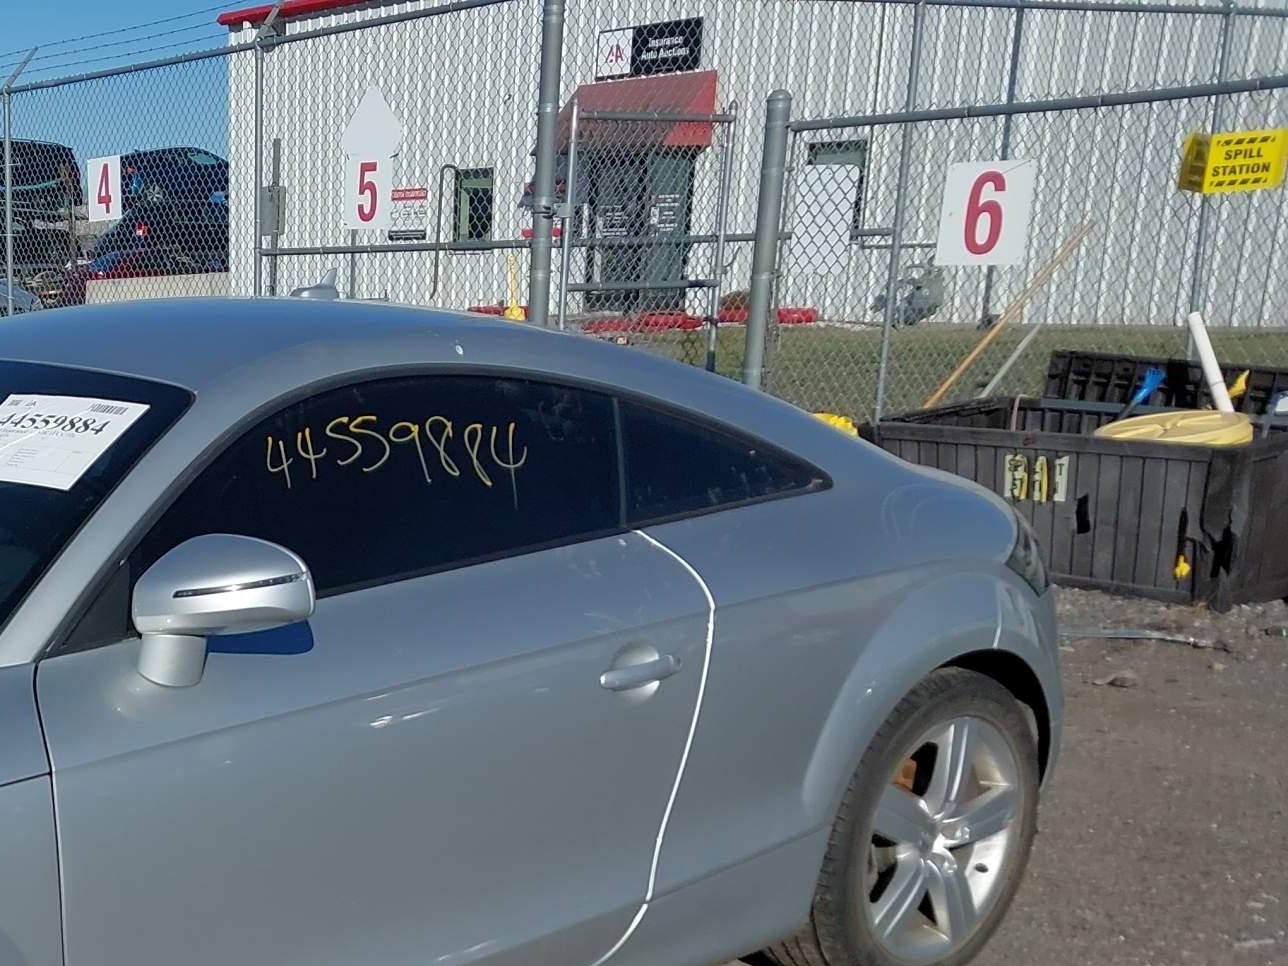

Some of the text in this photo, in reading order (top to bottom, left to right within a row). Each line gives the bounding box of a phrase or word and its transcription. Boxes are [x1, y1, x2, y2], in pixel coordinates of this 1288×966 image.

[641, 47, 690, 60] Auto Auctions
[648, 36, 684, 47] Insurance
[1212, 162, 1271, 177] STATION
[1224, 148, 1263, 160] SPILL
[97, 163, 112, 214] 4
[357, 161, 378, 222] 5
[964, 170, 1006, 255] 6
[266, 415, 528, 508] 44559884
